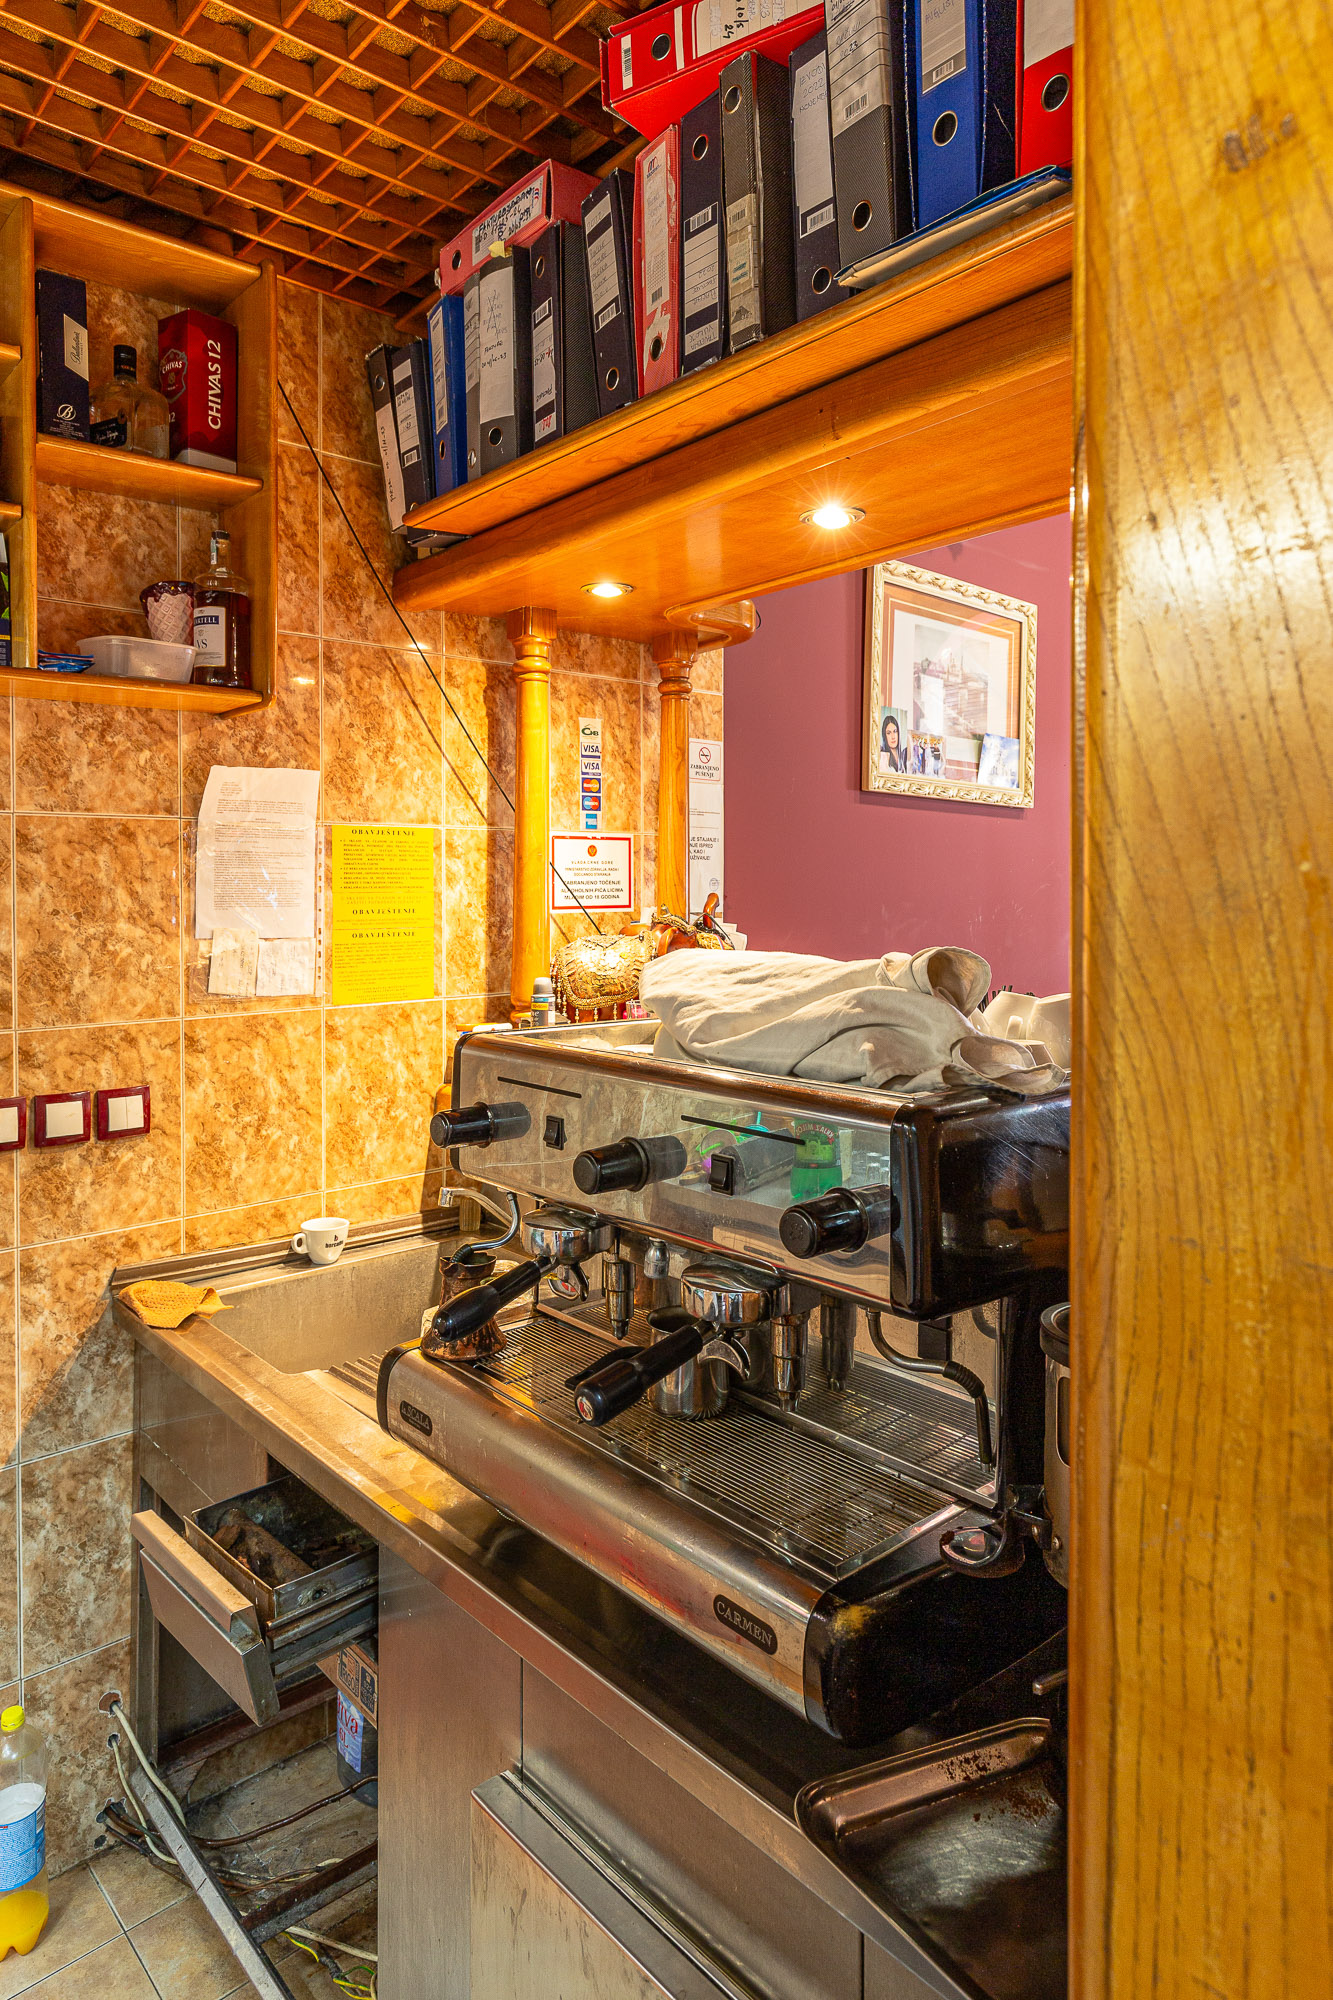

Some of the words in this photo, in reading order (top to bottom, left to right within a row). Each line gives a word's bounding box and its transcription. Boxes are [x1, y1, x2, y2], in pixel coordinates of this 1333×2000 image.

[207, 339, 222, 360] 12
[162, 361, 183, 374] CHIVAS
[208, 363, 223, 430] CHIVAS
[583, 745, 600, 753] VISA
[583, 762, 600, 771] VISA
[716, 1601, 773, 1648] CARMEN
